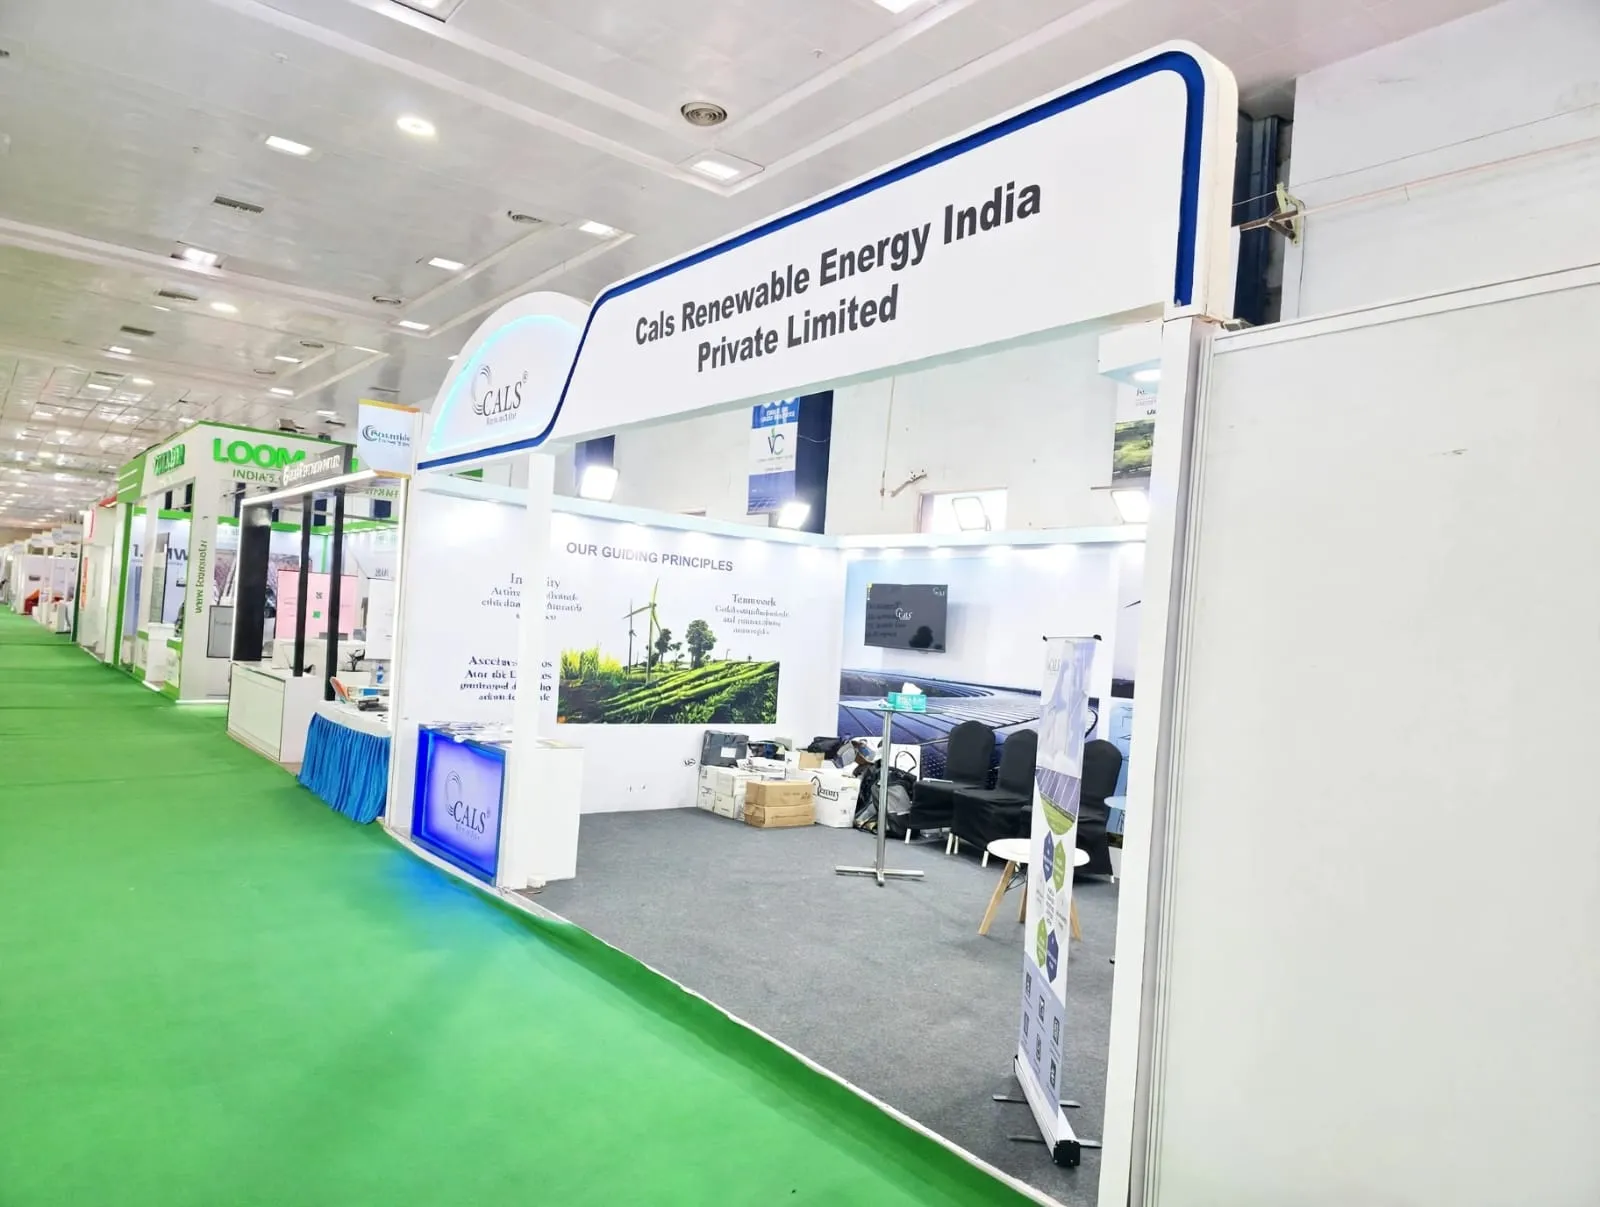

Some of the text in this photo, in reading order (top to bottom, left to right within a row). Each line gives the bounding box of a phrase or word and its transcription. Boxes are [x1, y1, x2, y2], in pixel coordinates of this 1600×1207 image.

[635, 181, 1041, 346] Cals Renewable Energy India
[697, 283, 899, 373] Private Limited
[483, 381, 522, 417] CALS
[213, 438, 306, 469] LOOM
[566, 542, 734, 572] OUR GUIDING PRINCIPLES
[453, 800, 486, 834] CALS
